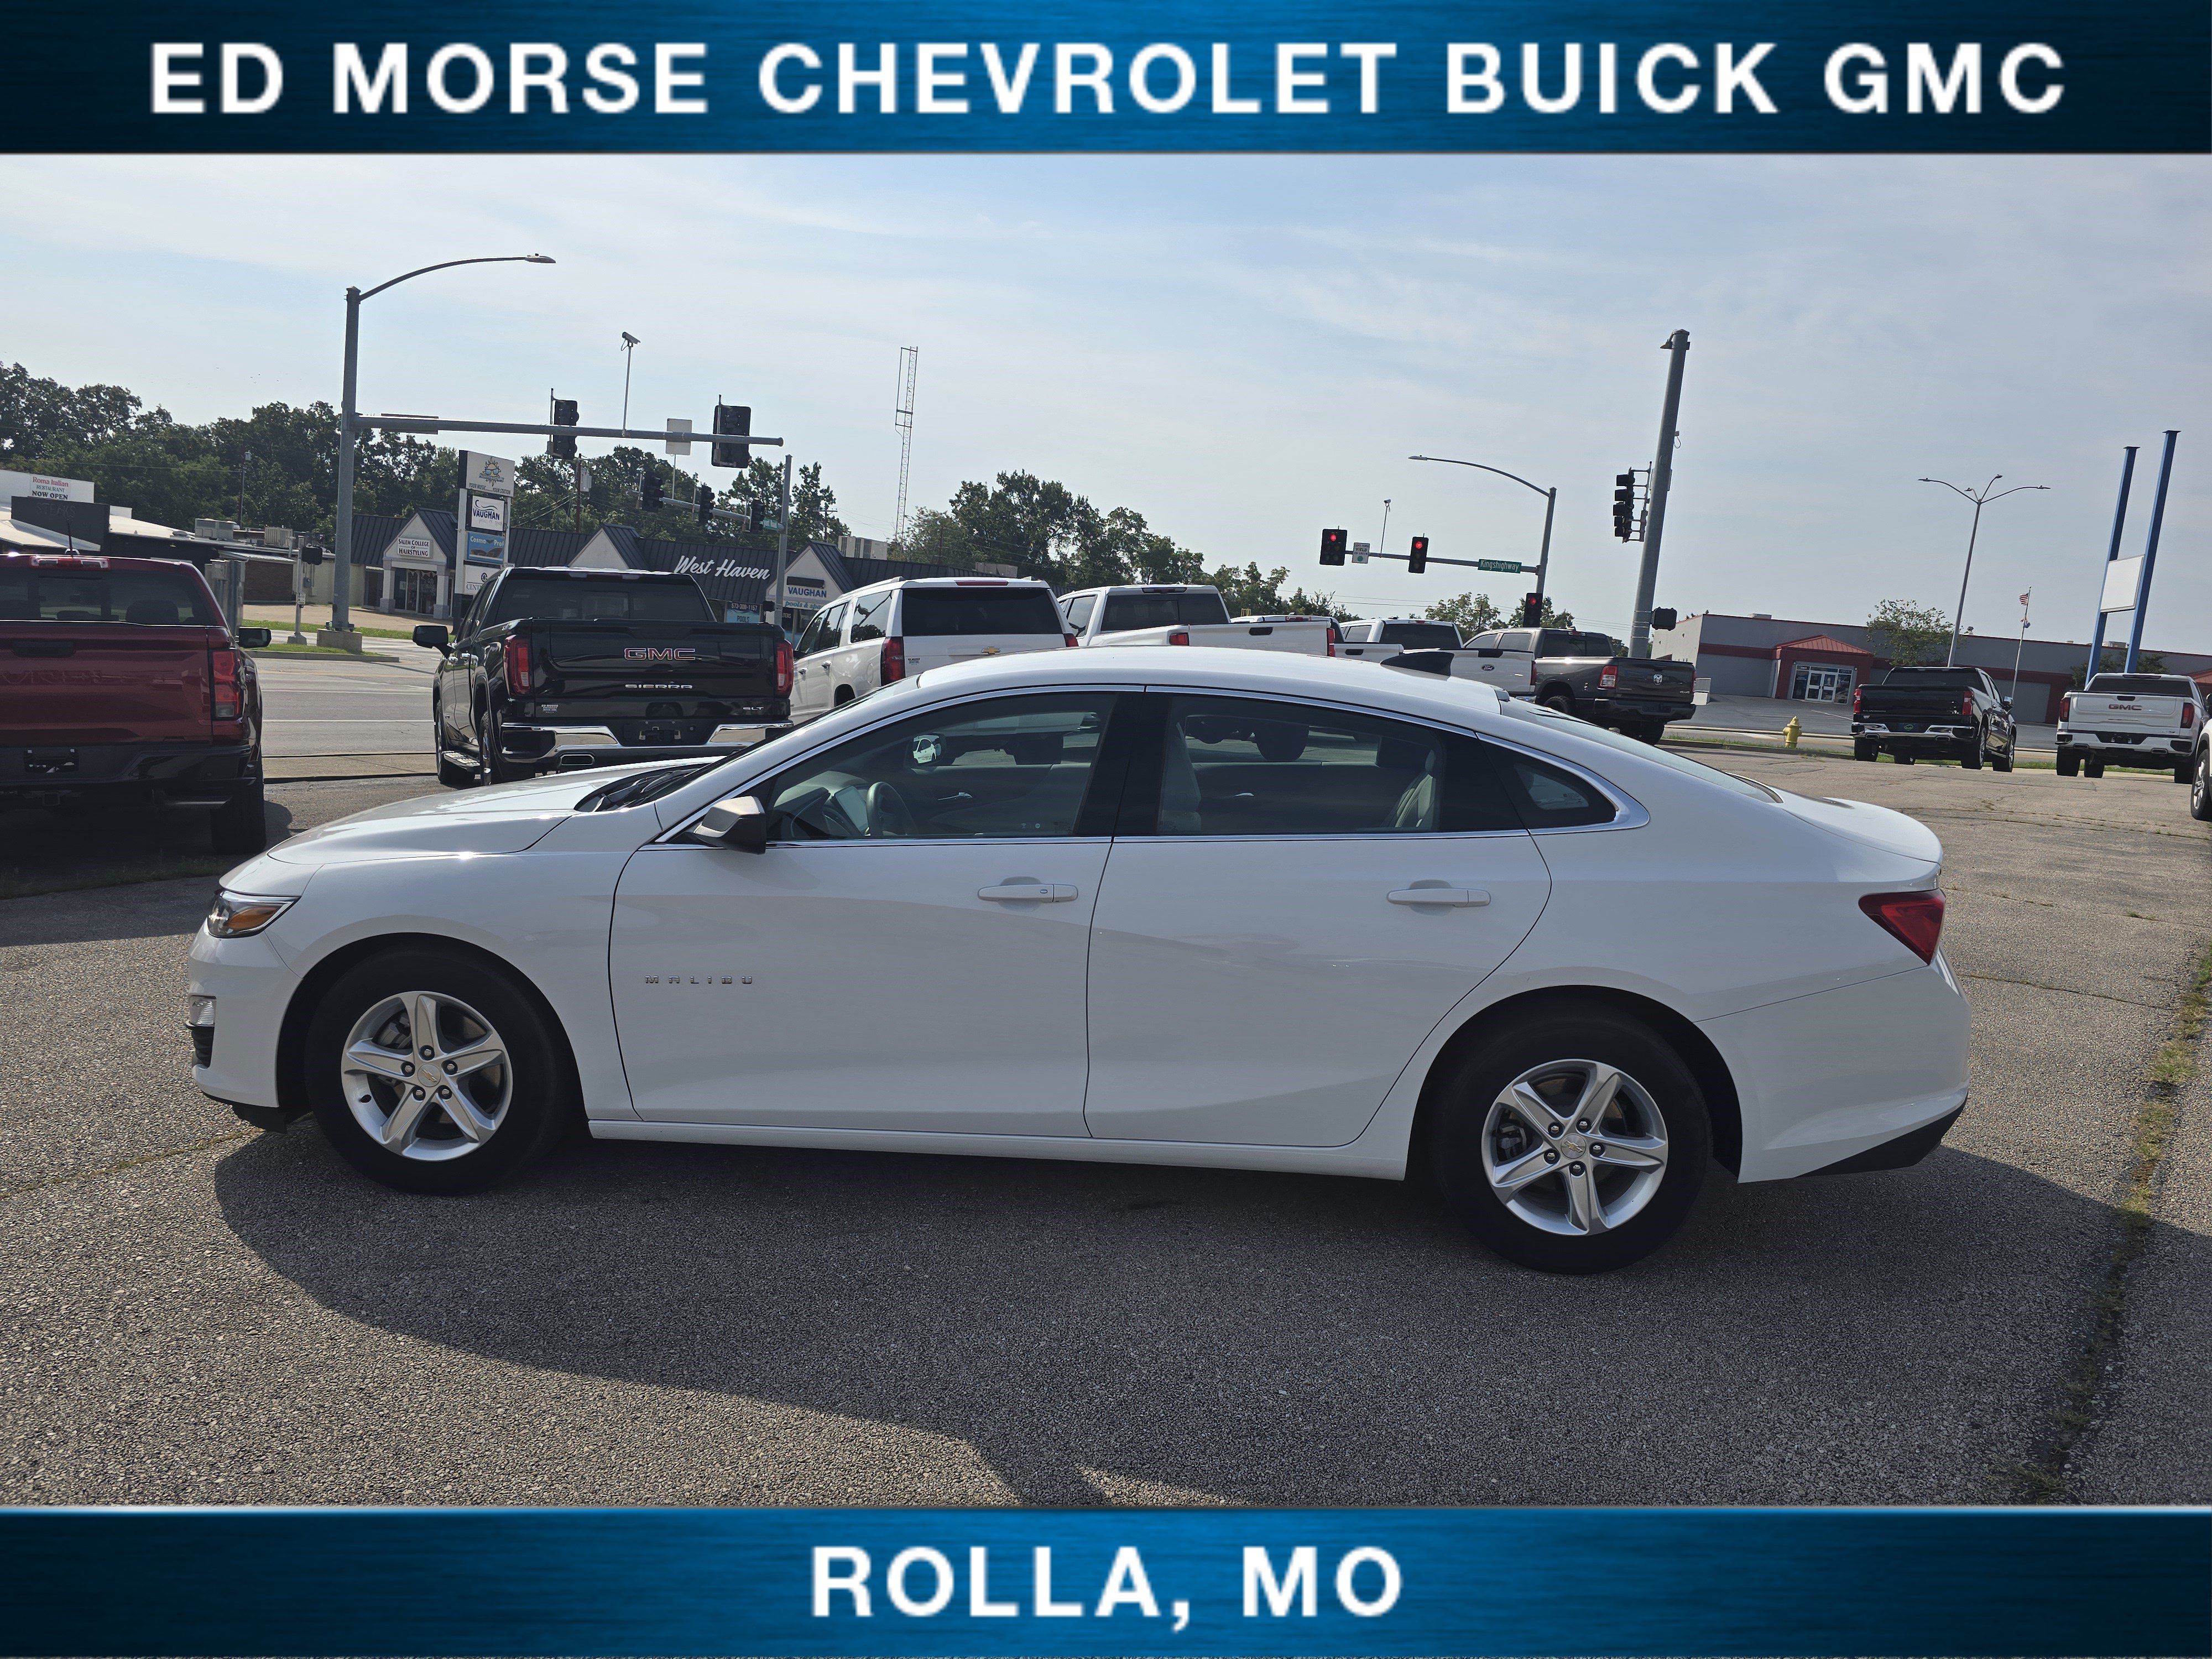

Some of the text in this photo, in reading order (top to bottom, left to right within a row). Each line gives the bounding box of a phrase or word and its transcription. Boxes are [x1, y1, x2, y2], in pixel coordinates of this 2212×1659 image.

[33, 476, 69, 487] Roma Italian
[36, 484, 65, 493] RESTAURANT
[473, 508, 500, 520] VAUGHAN
[470, 536, 504, 547] Cosmo Prof
[673, 555, 770, 580] West Haven
[1480, 560, 1520, 572] Kingshighway
[788, 587, 827, 598] VAUGHAN
[624, 648, 696, 660] GMC
[645, 975, 753, 984] MALIBU
